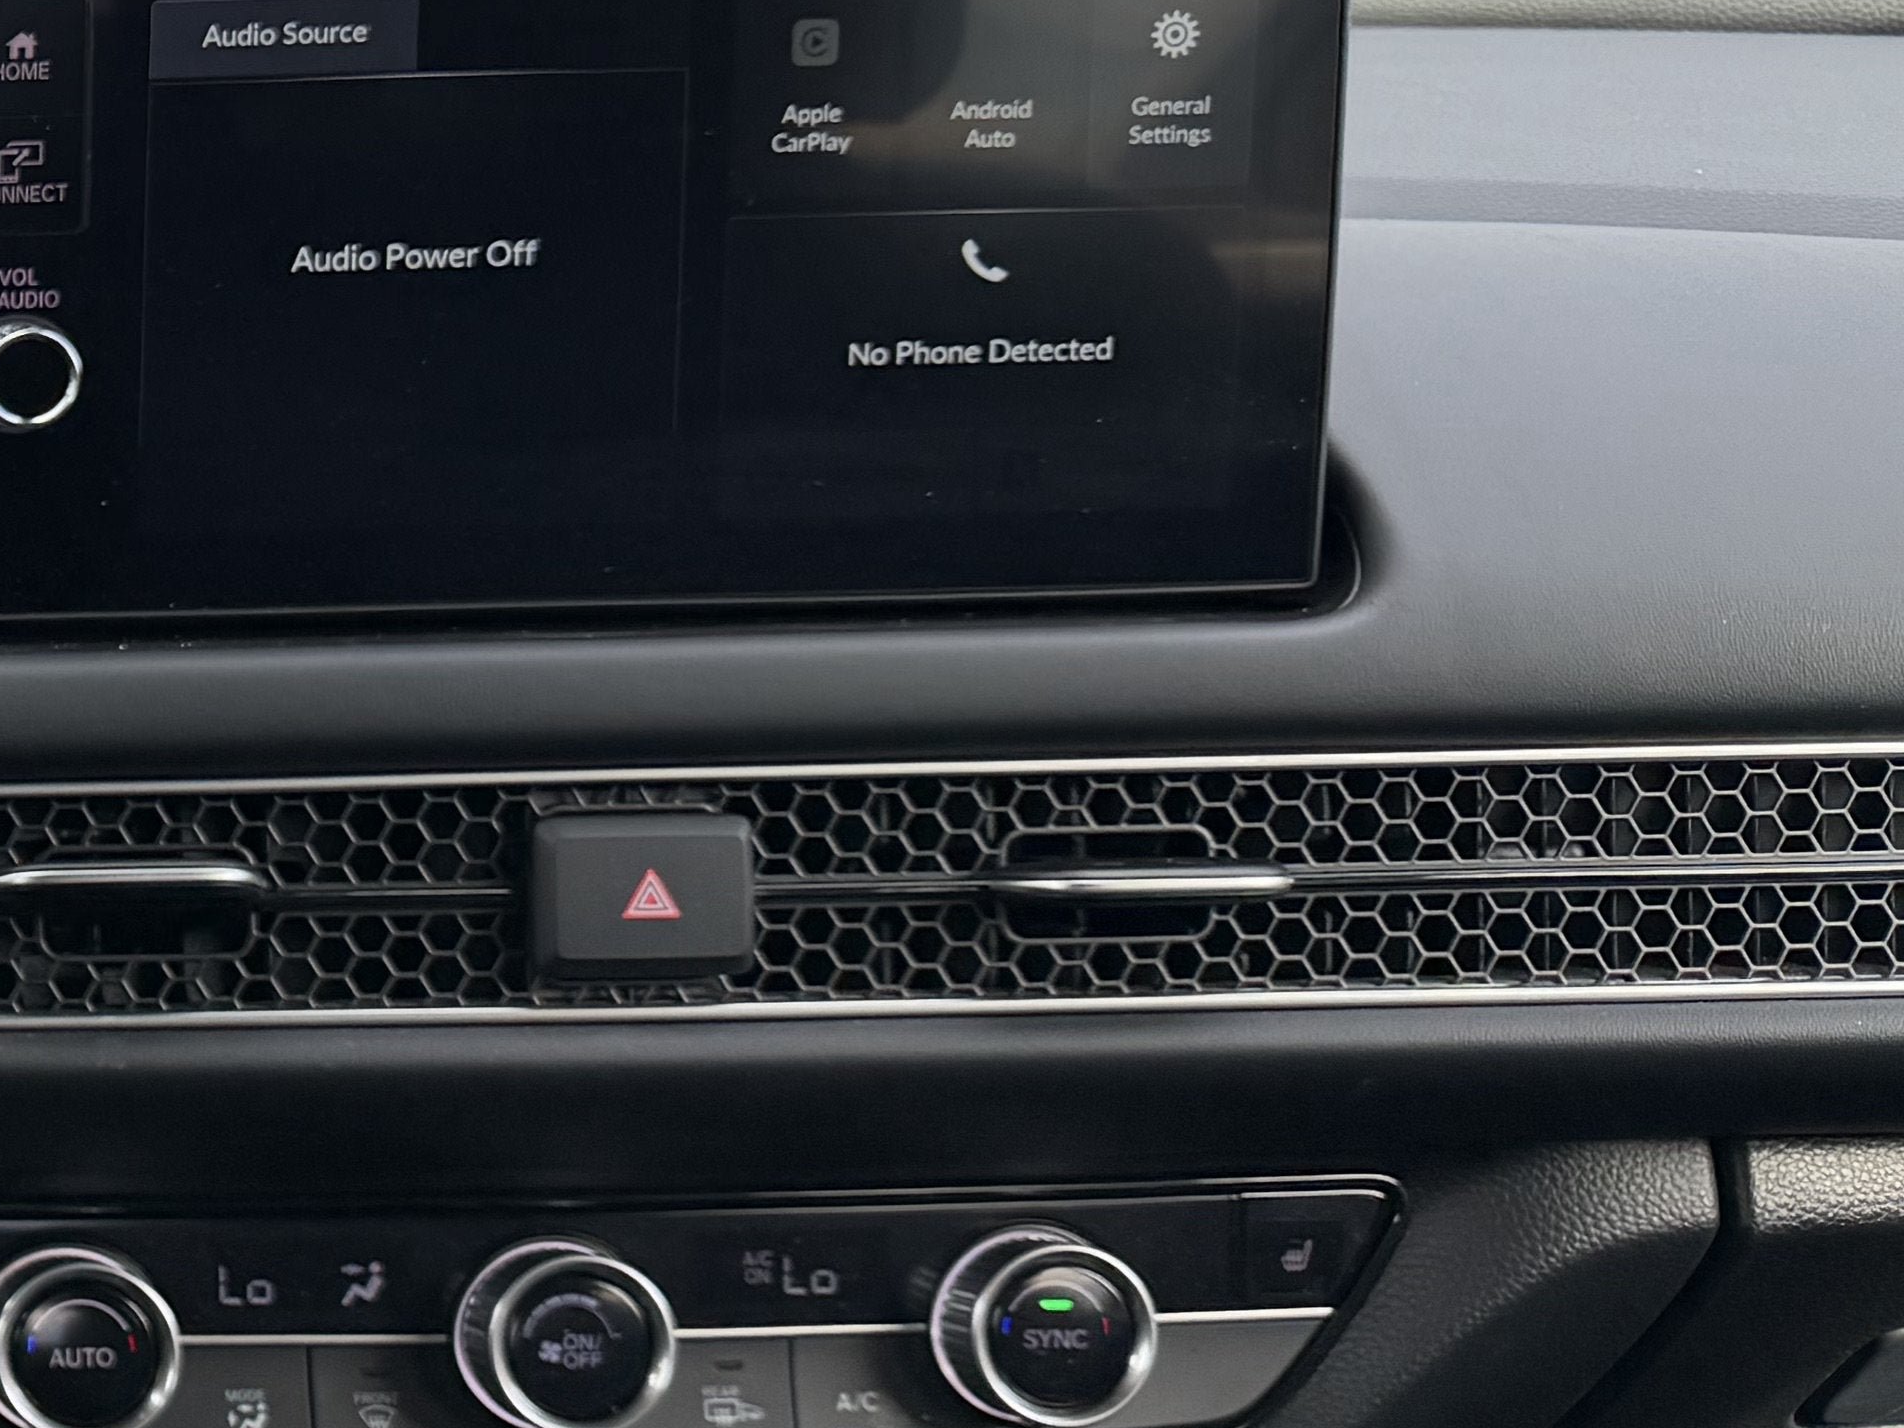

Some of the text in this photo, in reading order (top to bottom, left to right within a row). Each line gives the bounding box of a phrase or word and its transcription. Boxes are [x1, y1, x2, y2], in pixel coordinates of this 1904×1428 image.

[201, 21, 371, 50] Audio Source
[780, 101, 845, 127] Apple
[949, 98, 1034, 121] Android
[1130, 95, 1213, 118] General
[770, 132, 853, 156] CarPlay
[963, 128, 1017, 150] Auto
[1127, 123, 1213, 148] Settings
[291, 238, 541, 273] Audio Power Off
[846, 336, 1115, 368] No Phone Detected
[1022, 1327, 1089, 1351] SYNC
[48, 1345, 118, 1370] AUTO
[562, 1350, 603, 1371] OFF
[835, 1390, 881, 1414] A/C
